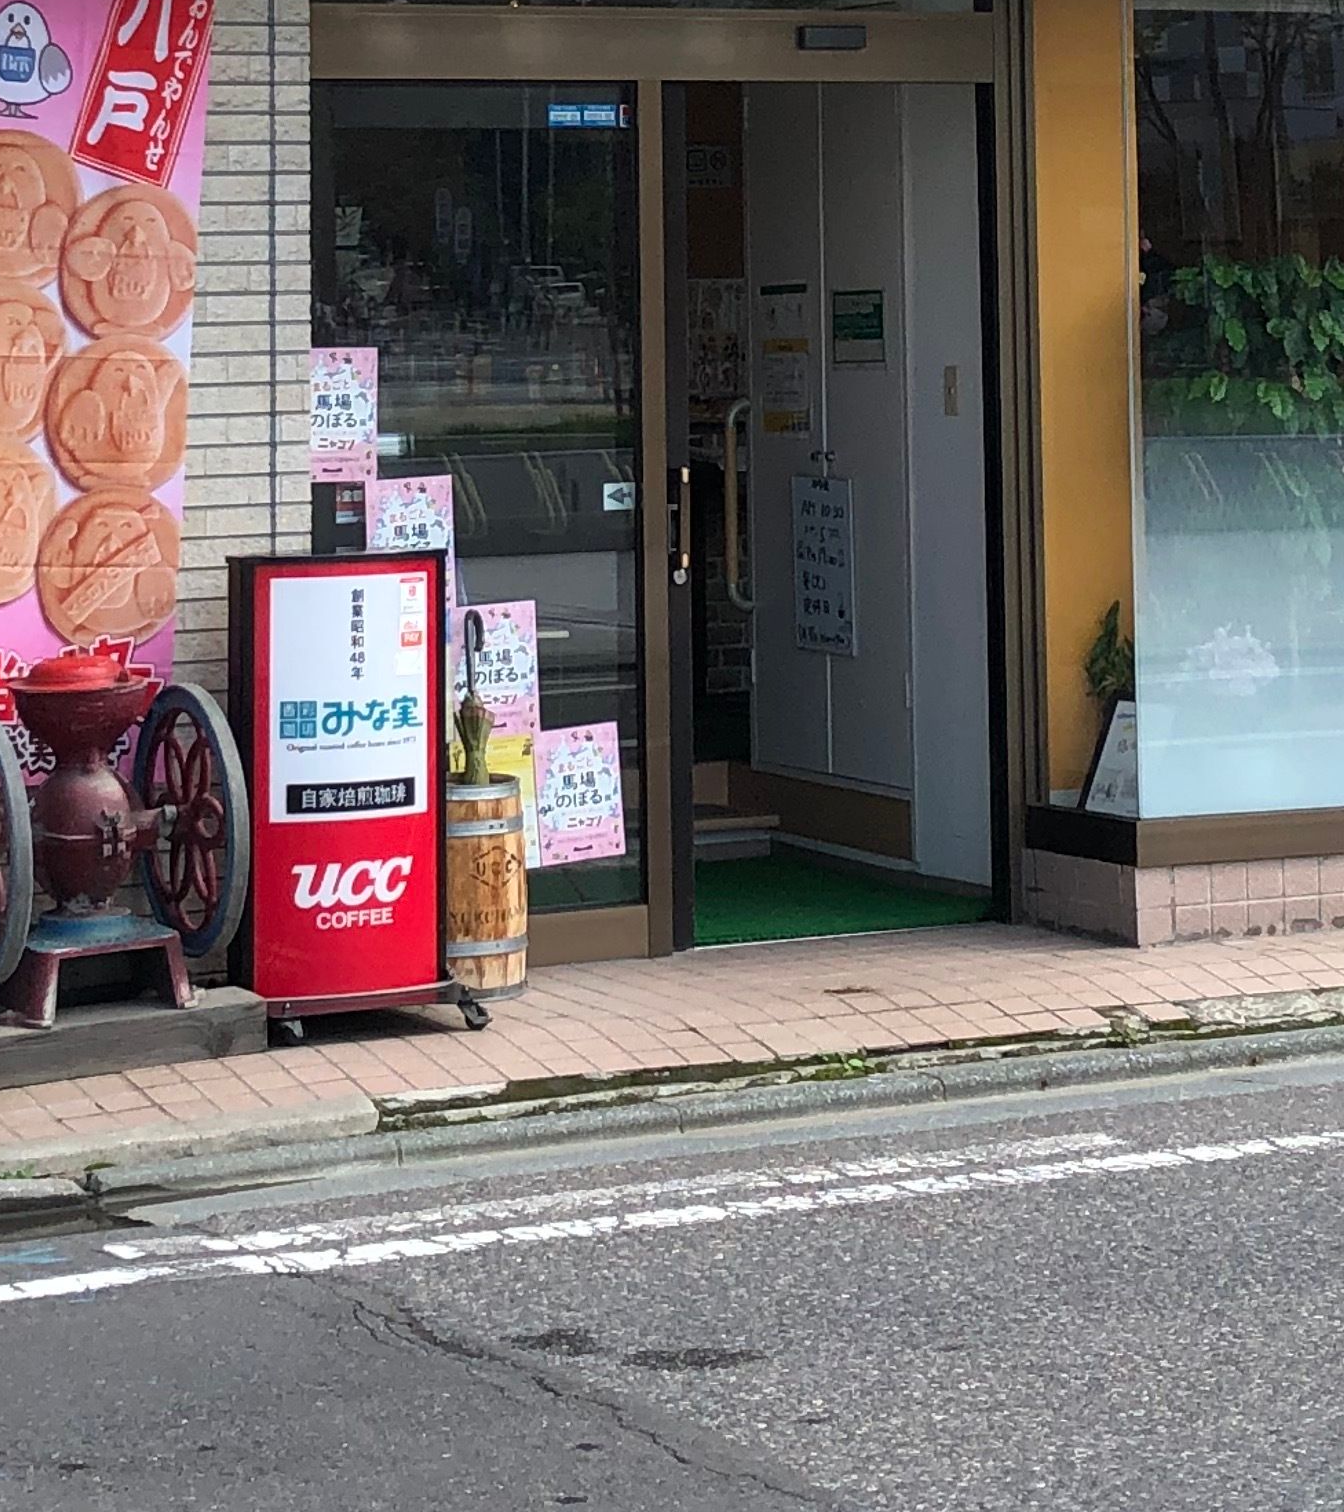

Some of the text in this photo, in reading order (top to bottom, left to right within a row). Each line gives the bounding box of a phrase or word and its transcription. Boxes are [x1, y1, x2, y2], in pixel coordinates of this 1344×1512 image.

[315, 393, 352, 411] 馬場
[394, 523, 430, 540] 馬場
[350, 589, 366, 680] 創業昭和48年
[477, 649, 513, 667] 馬場
[322, 695, 423, 736] みな実
[561, 771, 596, 790] 馬場
[301, 785, 407, 809] 自家焙煎珈琲
[316, 907, 395, 930] COFFEE
